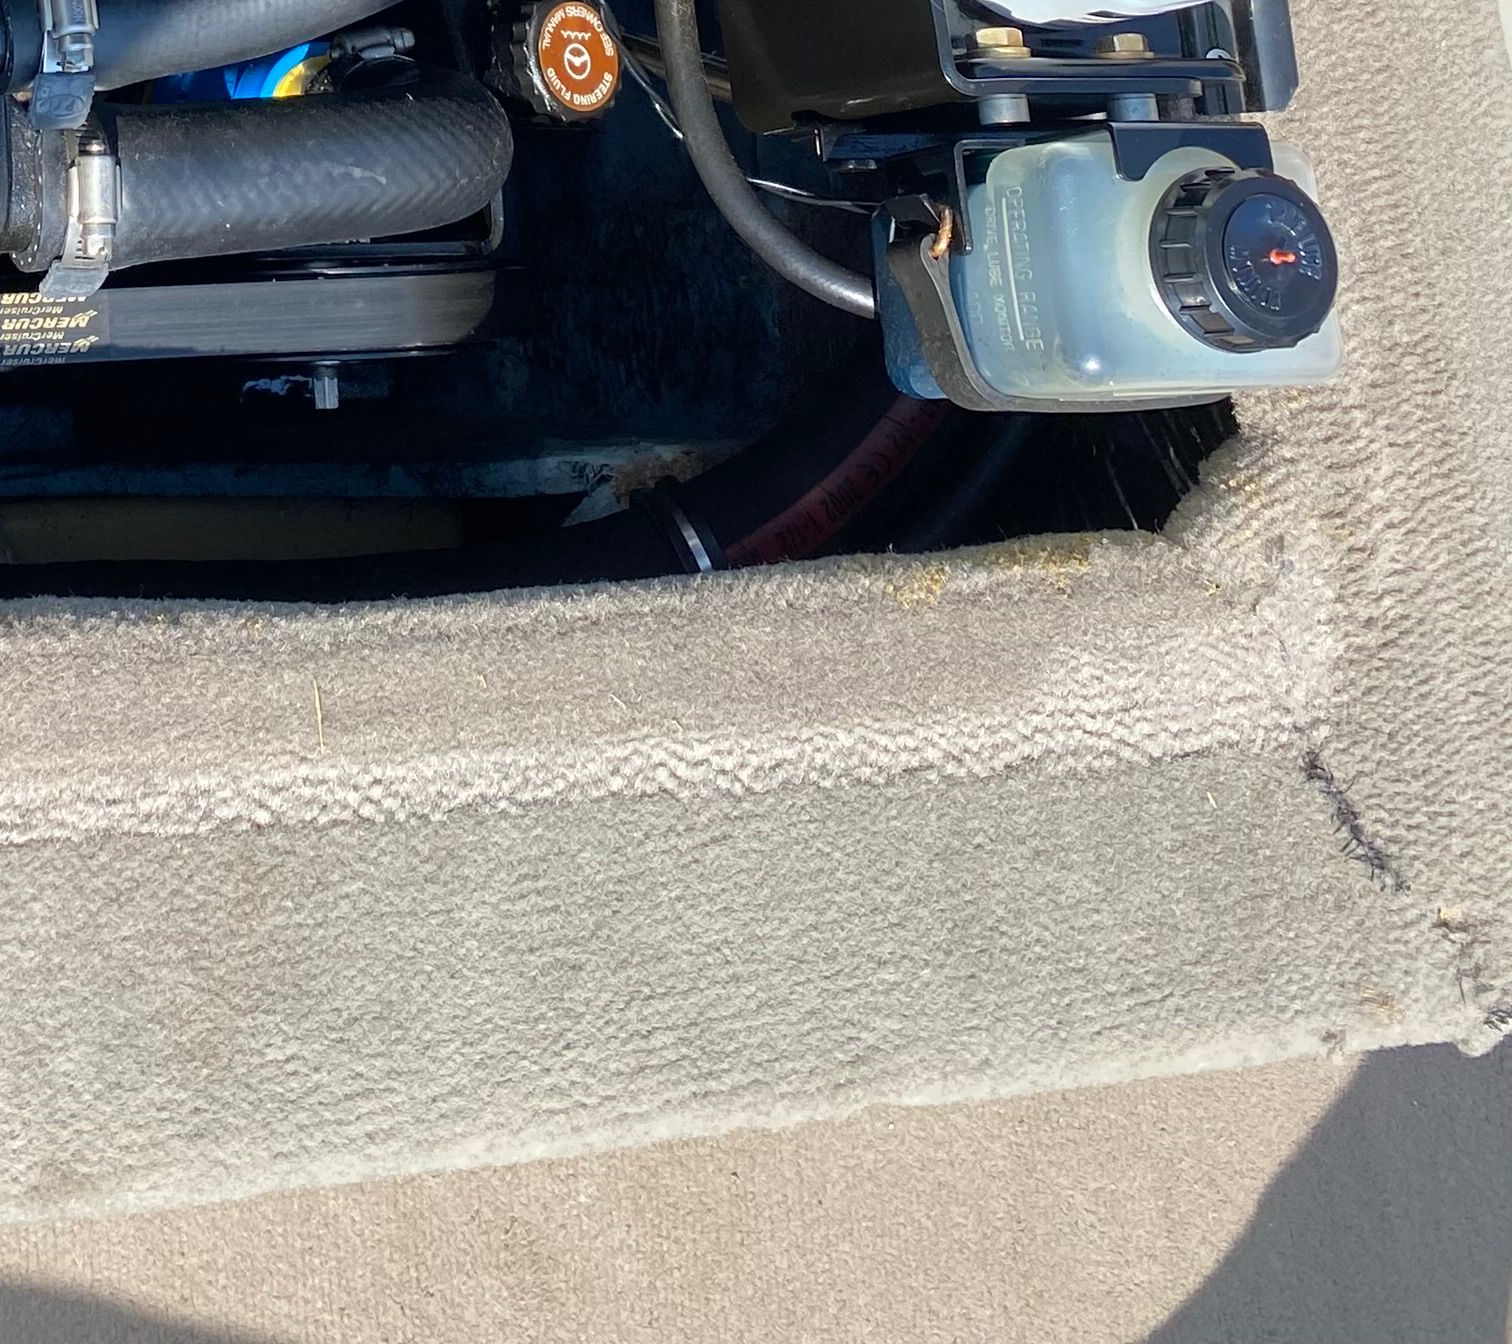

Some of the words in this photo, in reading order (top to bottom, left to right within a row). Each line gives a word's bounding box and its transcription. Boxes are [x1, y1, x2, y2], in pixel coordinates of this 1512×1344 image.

[542, 9, 567, 49] MANUAL
[566, 5, 604, 33] OWNERS
[598, 32, 614, 58] SEE
[546, 67, 572, 102] FLUID
[573, 71, 614, 106] STEERING
[1010, 185, 1033, 282] OPERATING
[986, 247, 1004, 287] LUBE
[0, 331, 64, 342] MerCruiser
[1019, 290, 1044, 352] RANGE
